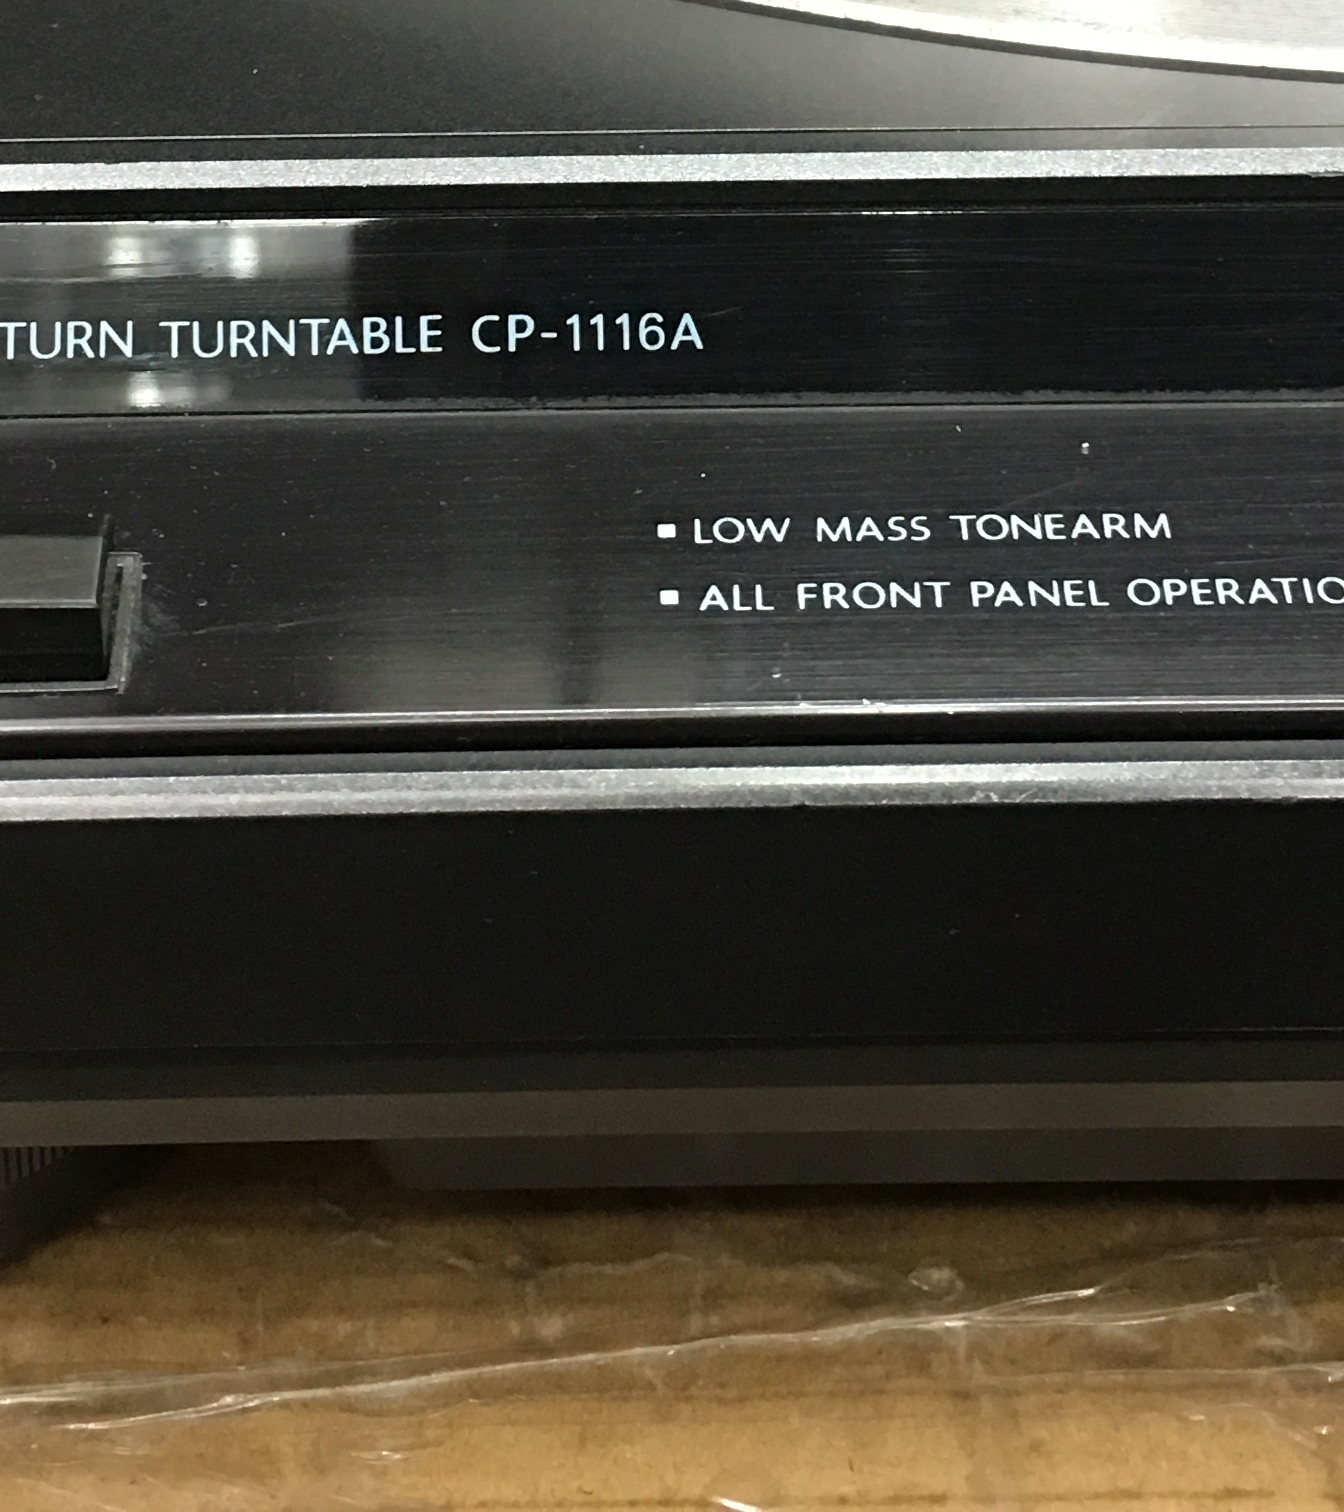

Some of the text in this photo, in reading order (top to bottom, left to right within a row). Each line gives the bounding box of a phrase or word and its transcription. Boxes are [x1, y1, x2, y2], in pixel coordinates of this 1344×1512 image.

[158, 314, 443, 359] TURNTABLE
[471, 312, 704, 353] CP-1116A
[694, 512, 1172, 544] LOW MASS TONEARM
[699, 584, 775, 611] ALL
[797, 581, 951, 610] FRONT
[970, 579, 1110, 608] PANEL
